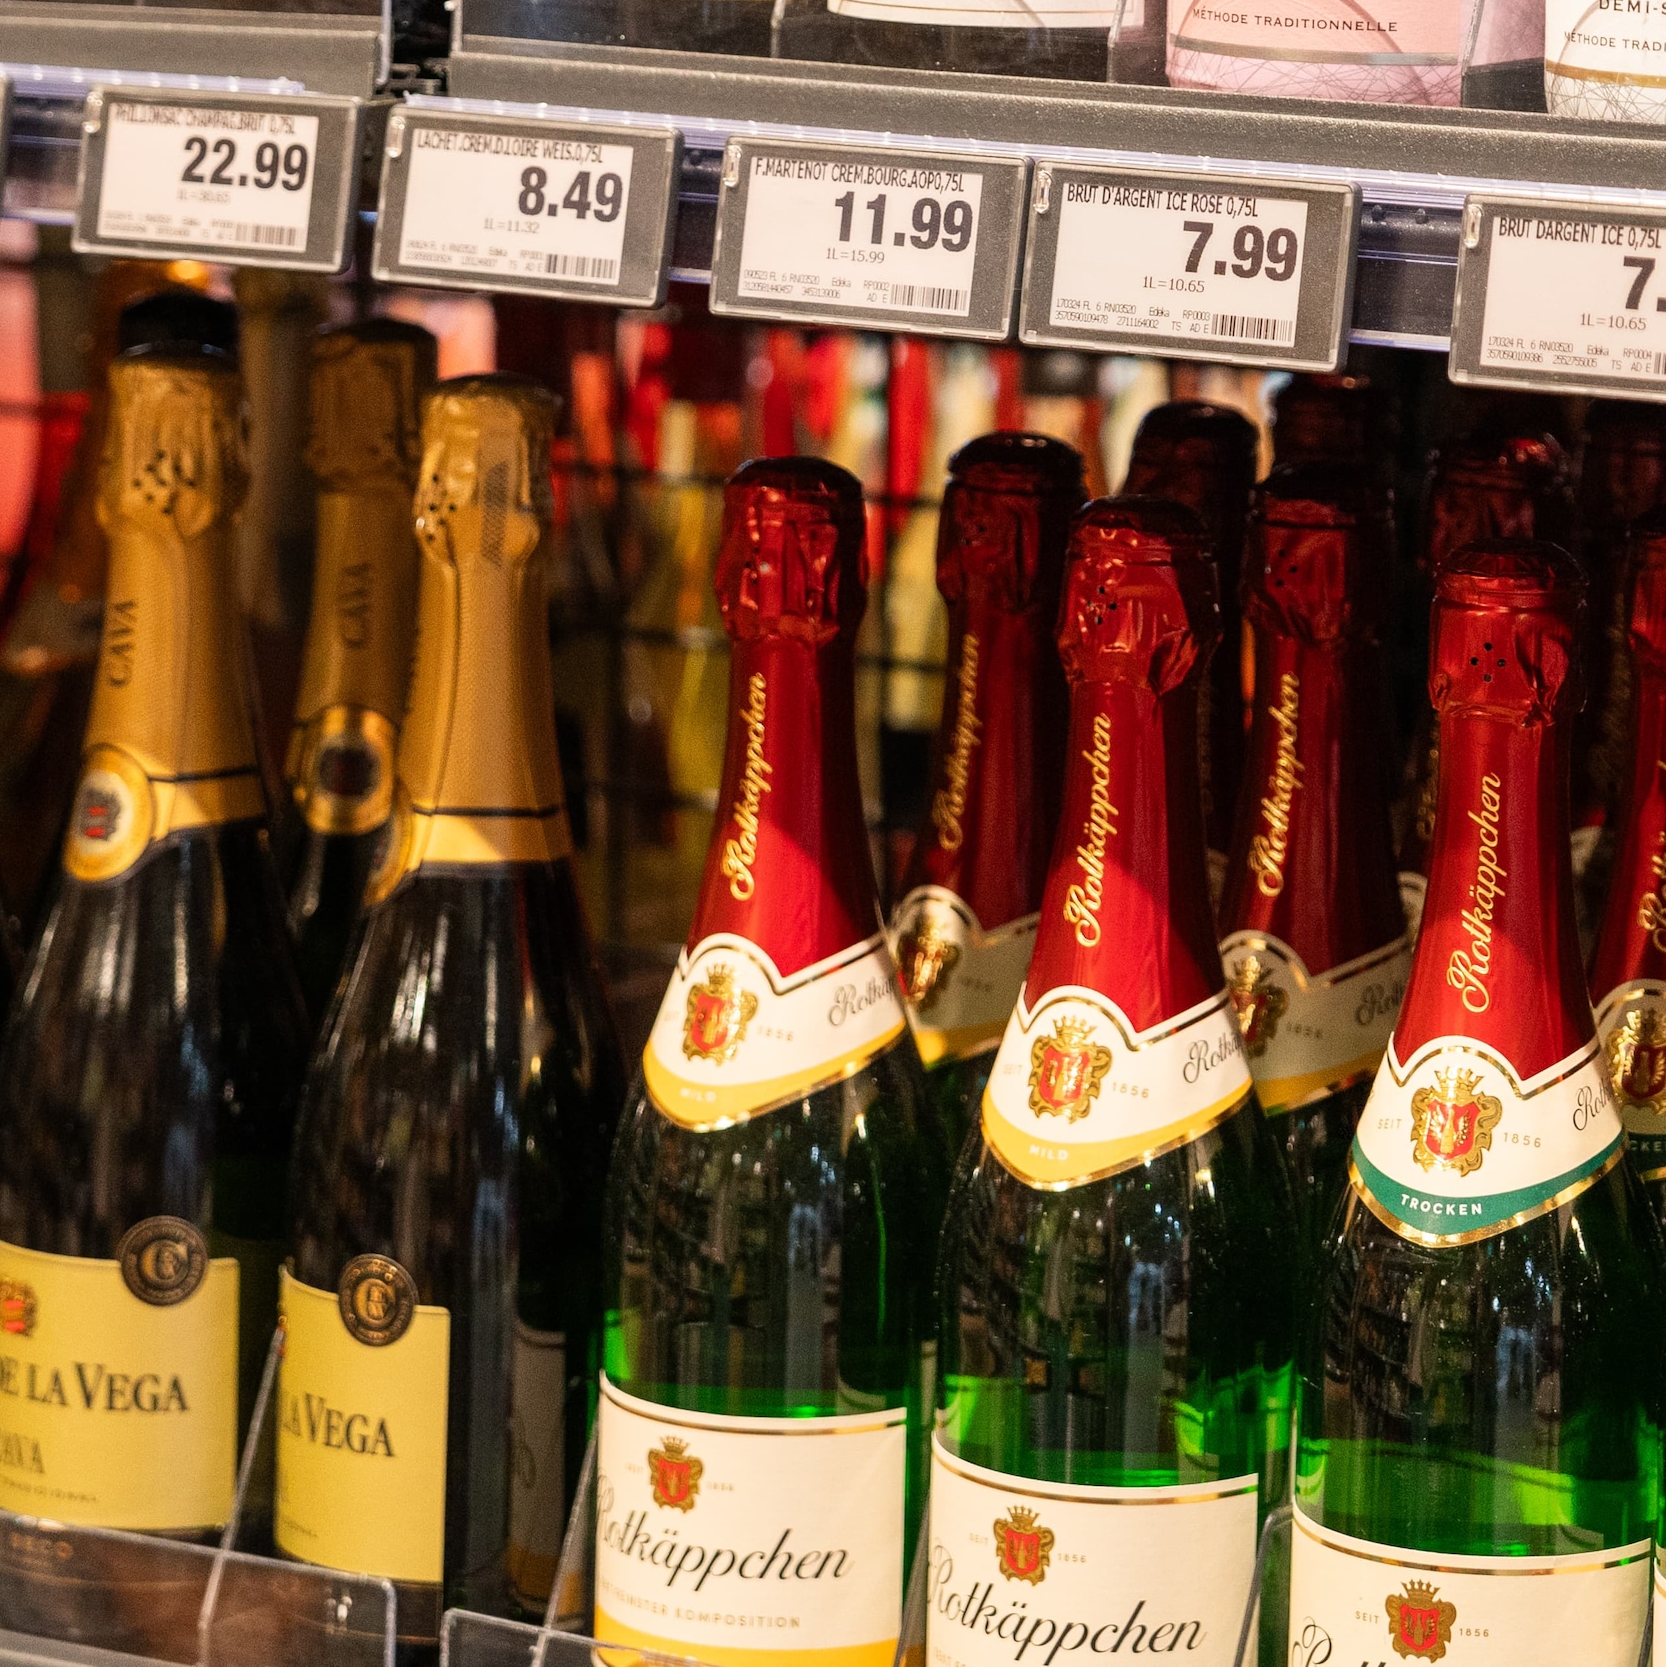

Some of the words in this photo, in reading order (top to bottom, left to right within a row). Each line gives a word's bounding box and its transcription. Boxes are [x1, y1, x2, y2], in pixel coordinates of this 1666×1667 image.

[1192, 5, 1249, 26] MÉTHODE
[1253, 13, 1398, 33] TRADITIONNELLE
[182, 136, 308, 191] 22.99
[755, 158, 827, 180] F.MARTENOT
[518, 166, 623, 222] 8.49
[1067, 185, 1098, 204] BRUT
[1102, 188, 1162, 210] D'ARGENT
[1166, 191, 1186, 211] ICE
[1191, 194, 1222, 215] ROSE
[1226, 197, 1258, 219] 0,75L
[483, 218, 540, 234] 1L=11.32
[834, 191, 973, 252] 11.99
[1499, 217, 1532, 237] BRUT
[1536, 221, 1597, 244] DARGENT
[1601, 226, 1624, 245] ICE
[1627, 229, 1662, 250] 0,75L
[826, 247, 885, 264] 1L=15.99
[1183, 221, 1298, 282] 7.99
[1143, 275, 1205, 293] 1L=10.65
[1055, 311, 1108, 324] 3570590109478
[1190, 323, 1200, 333] AD
[1204, 324, 1209, 333] E
[1056, 298, 1080, 309] 170324
[1096, 302, 1101, 311] 6
[1149, 307, 1170, 317] Edeka
[1183, 310, 1210, 320] RP0003
[1580, 313, 1647, 331] 1L=10.65
[1488, 336, 1514, 347] 170324
[1587, 345, 1609, 356] Edeka
[1624, 348, 1652, 359] RP0004
[1631, 362, 1642, 371] AD
[106, 599, 138, 688] CAVA
[721, 672, 773, 902] Rotkäppchen
[1064, 713, 1119, 948] Rotkäppchen
[1447, 771, 1502, 1014] Rotkäppchen
[1112, 1082, 1150, 1100] 1856
[1377, 1117, 1403, 1131] SEIT
[1503, 1130, 1543, 1150] 1856
[1399, 1193, 1483, 1217] TROCKEN
[25, 1362, 68, 1408] LA
[74, 1362, 189, 1414] VEGA
[304, 1392, 396, 1458] VEGA
[598, 1474, 856, 1592] Rotkäppchen
[1057, 1553, 1088, 1564] 1856
[928, 1538, 1207, 1667] Rotkäppchen
[1355, 1610, 1379, 1625] SEIT
[1458, 1627, 1490, 1638] 1856
